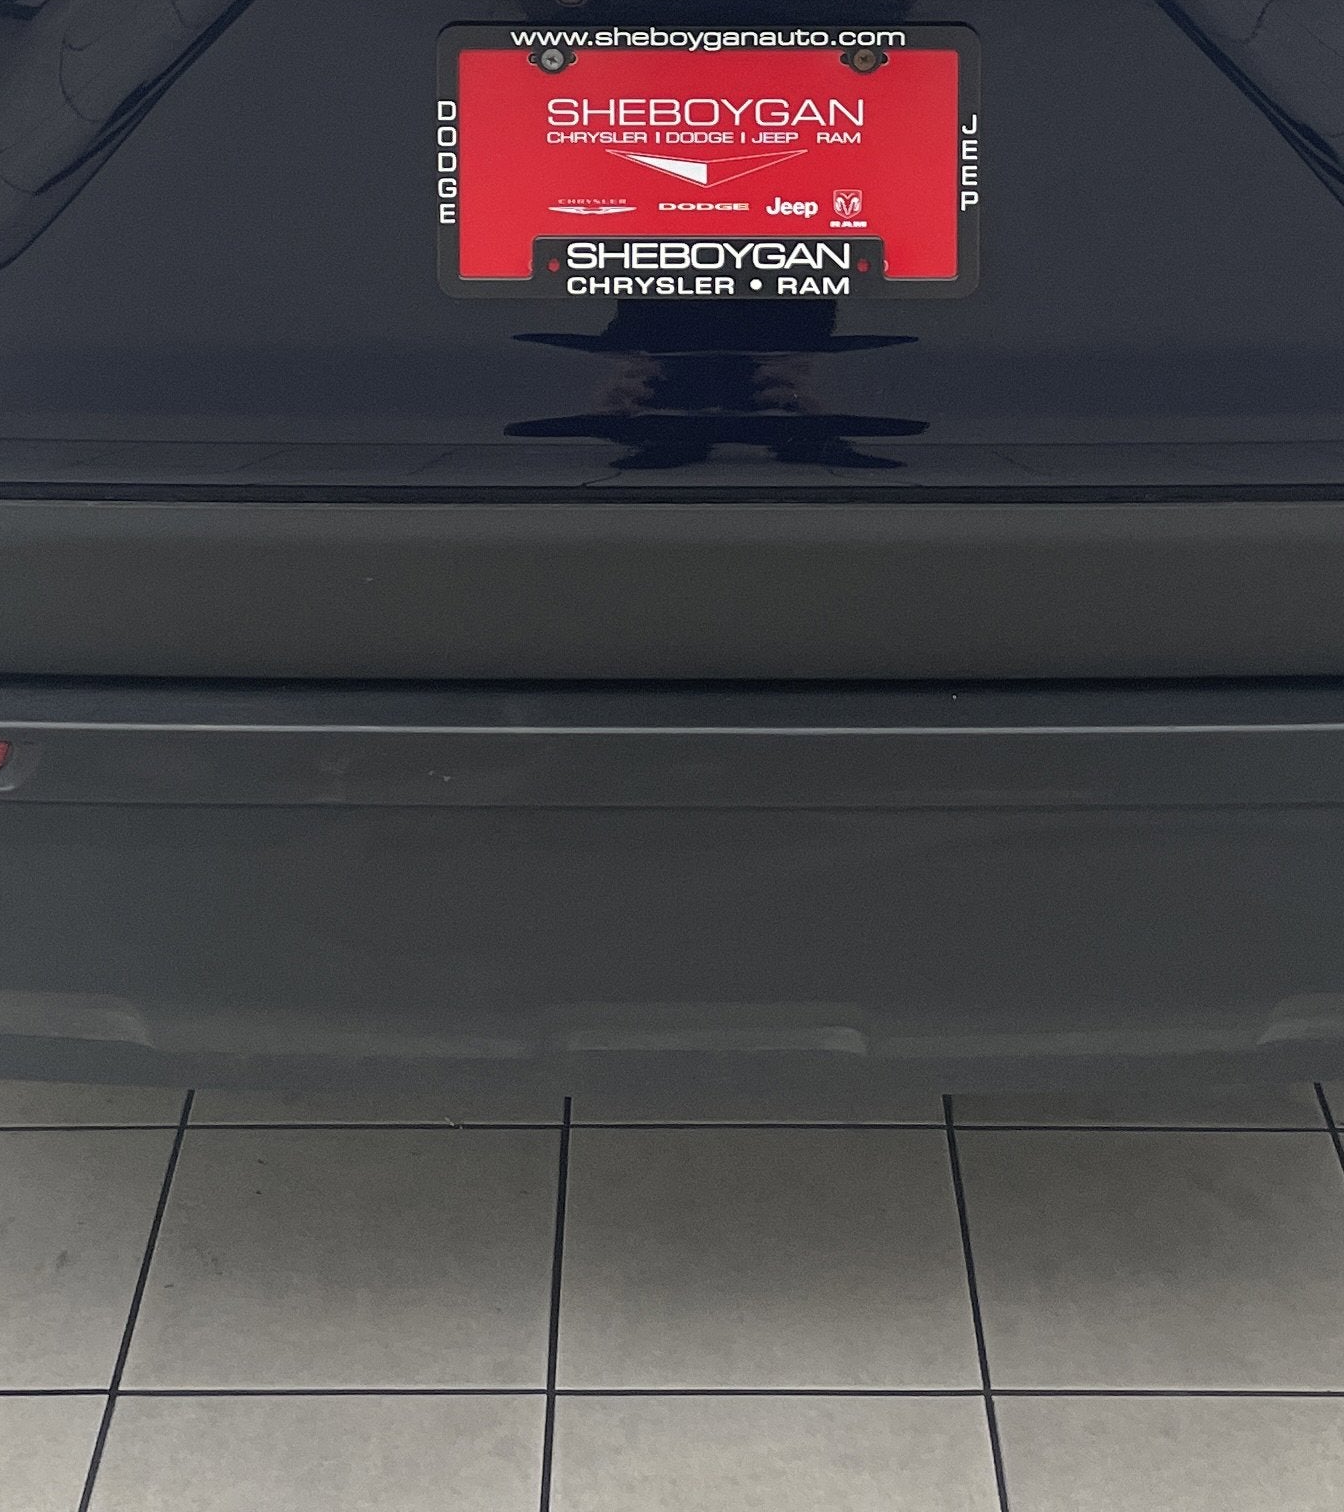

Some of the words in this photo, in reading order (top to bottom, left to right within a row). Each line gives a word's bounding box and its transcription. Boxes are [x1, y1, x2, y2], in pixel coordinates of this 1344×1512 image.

[511, 28, 906, 51] www.sheboyganauto.com
[547, 98, 865, 127] SHEBOYGAN
[546, 131, 648, 144] CHRYSLER
[665, 131, 735, 144] DODGE
[752, 131, 799, 144] JEEP
[816, 131, 862, 144] RAM
[437, 100, 457, 224] DODGE
[961, 114, 979, 211] JEEP
[658, 202, 750, 211] DODGE
[765, 197, 818, 218] Jeep
[567, 242, 851, 271] SHEBOYGAN
[566, 277, 734, 295] CHRYSLER
[777, 277, 850, 295] RAM
